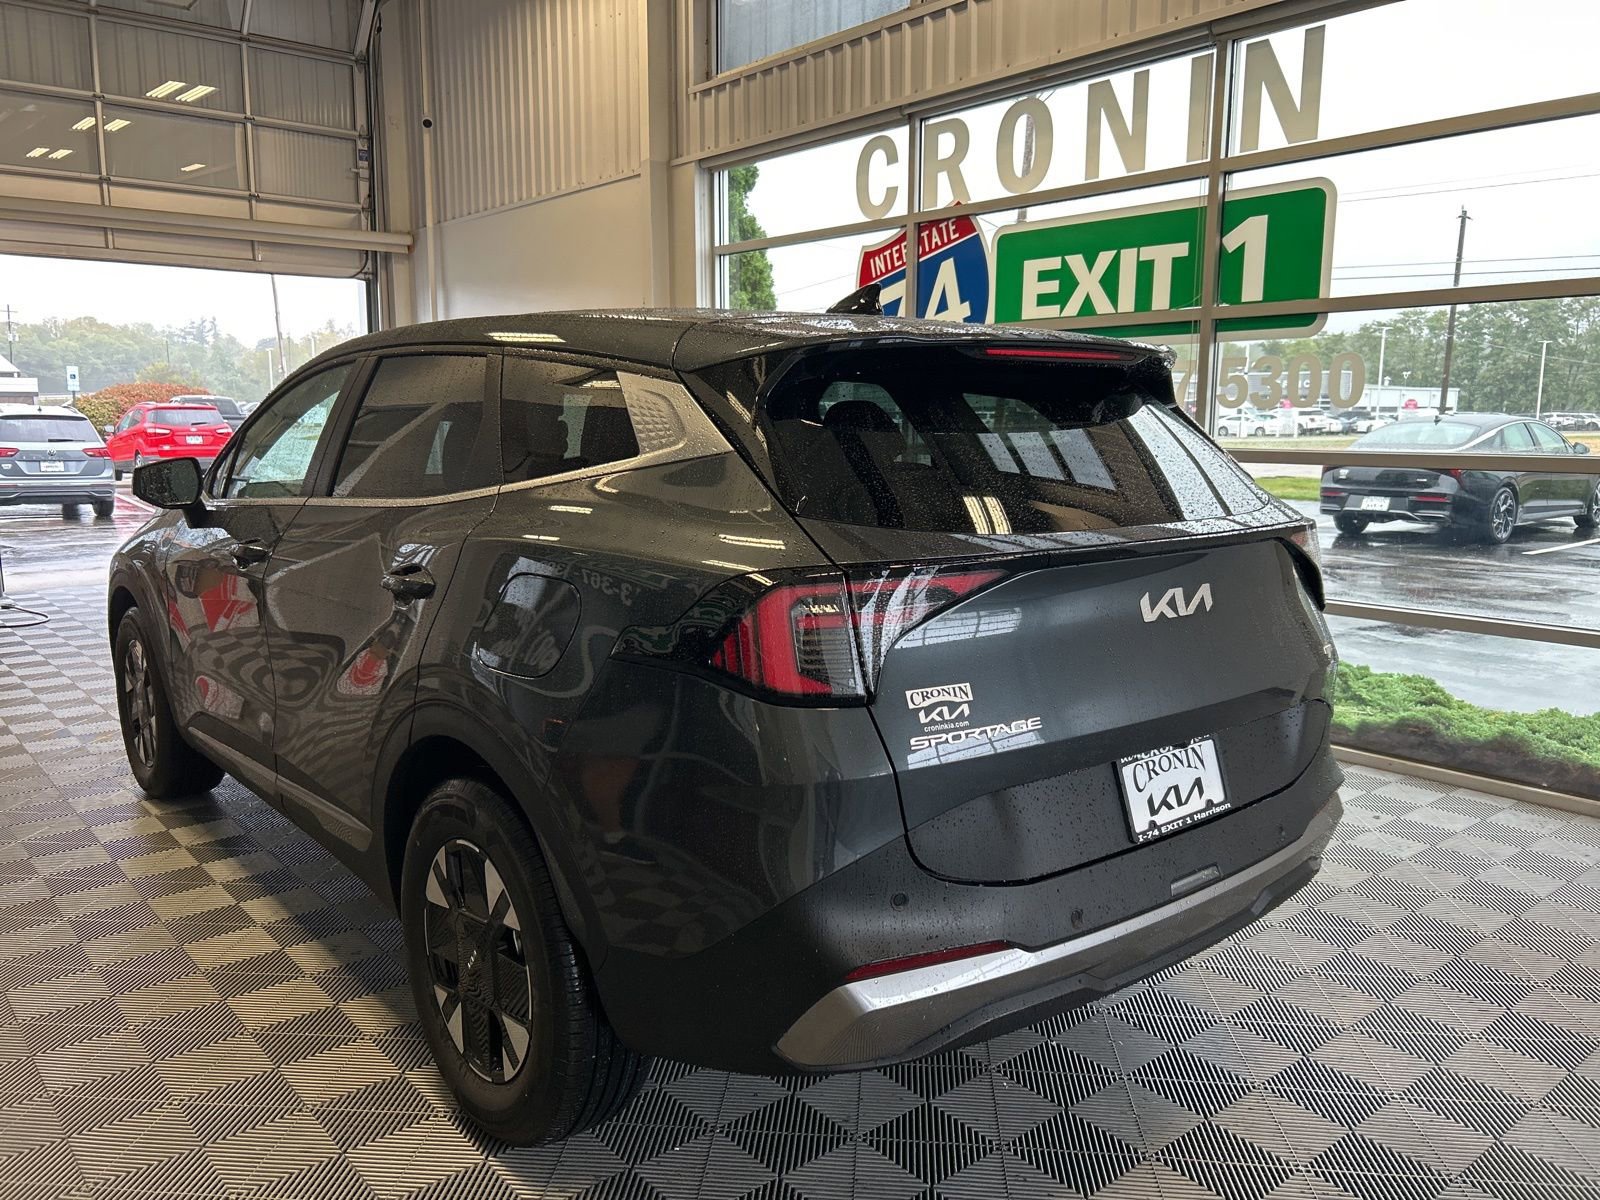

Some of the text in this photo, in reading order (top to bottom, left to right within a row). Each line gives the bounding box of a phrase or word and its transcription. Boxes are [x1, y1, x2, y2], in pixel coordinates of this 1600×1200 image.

[856, 25, 1325, 219] CRONIN
[1021, 214, 1268, 320] EXIT 1
[1139, 582, 1213, 623] KIA
[910, 685, 970, 706] CRONIN
[918, 703, 970, 723] KIA
[909, 717, 1042, 750] SPORTAGE
[924, 721, 970, 733] croninkia.com
[1132, 744, 1207, 793] CRONIN
[1147, 776, 1205, 817] KIA
[1137, 802, 1231, 842] I-74 EXIT 1 Harrison
